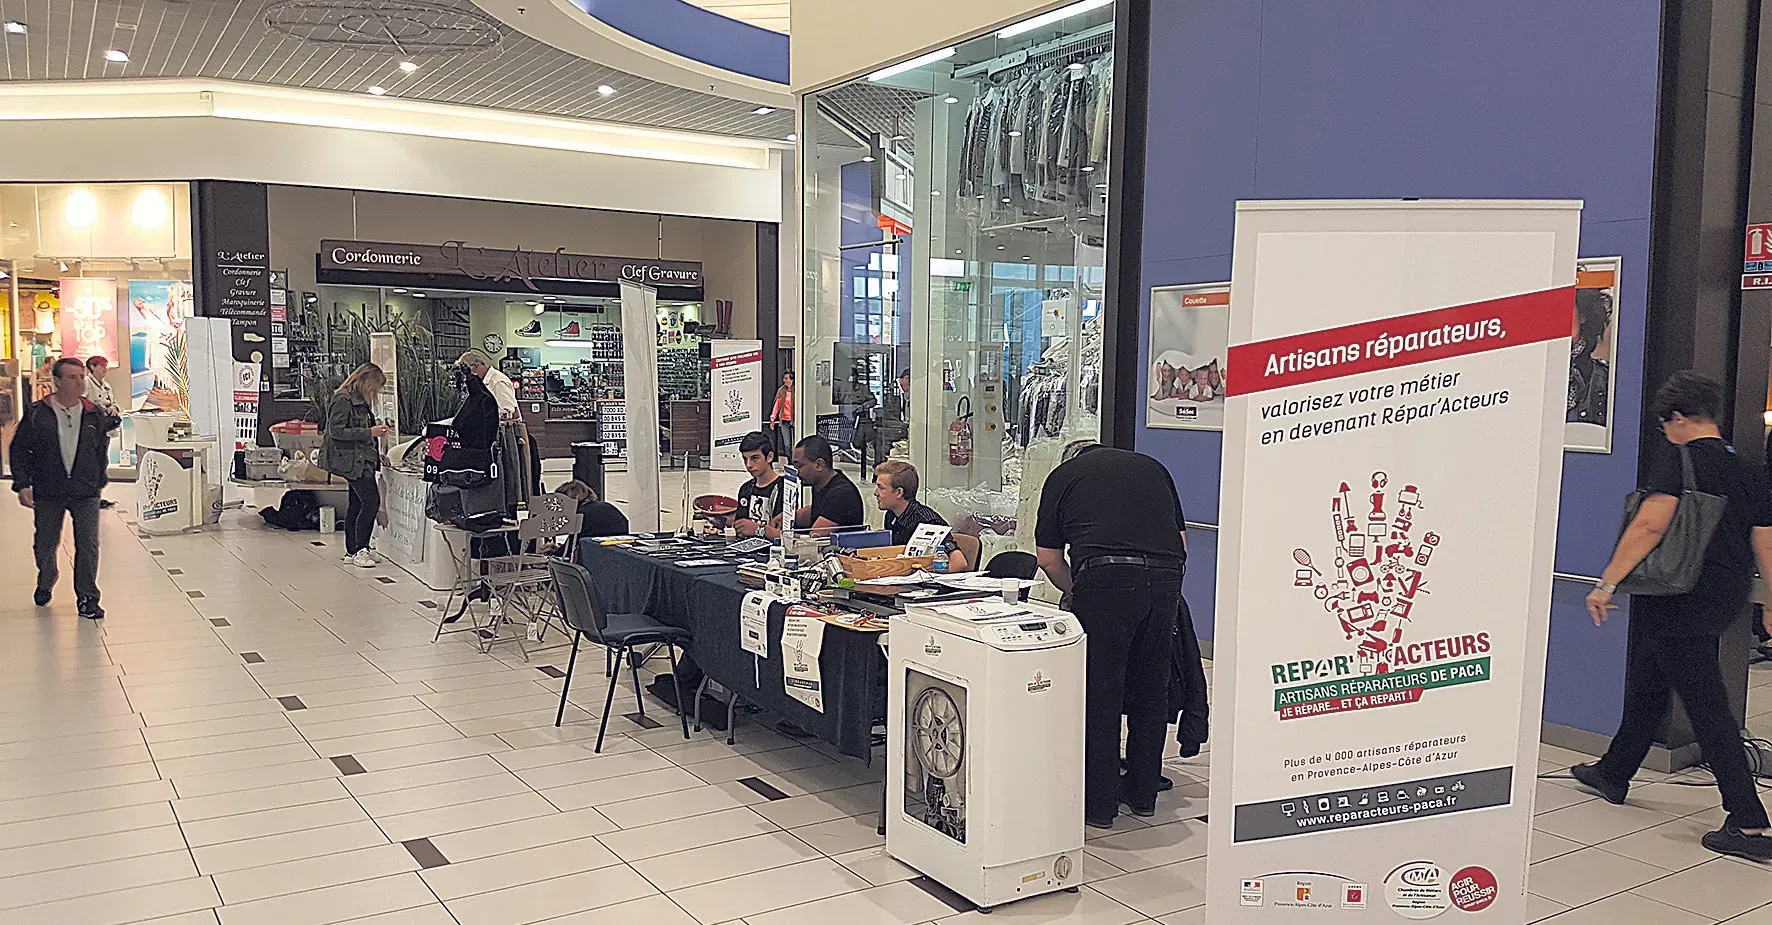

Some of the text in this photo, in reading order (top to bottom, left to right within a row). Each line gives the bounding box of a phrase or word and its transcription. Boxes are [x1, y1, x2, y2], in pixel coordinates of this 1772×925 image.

[217, 251, 265, 263] L'Atelier
[331, 247, 421, 265] Cordonnerie
[222, 267, 262, 276] Cordonnerie
[440, 240, 606, 292] L'Atelier
[621, 264, 698, 282] Clef Gravure
[235, 277, 252, 287] Clef
[229, 288, 257, 297] Gravure
[1184, 296, 1207, 305] Couette
[221, 298, 266, 307] Maroquinerie
[231, 318, 257, 328] Tampon
[75, 327, 107, 343] TOP
[1263, 317, 1508, 377] Artisans réparateurs,
[1260, 370, 1462, 420] valorisez votre métier
[1260, 388, 1510, 446] en devenant Répar'Acteurs
[1271, 632, 1492, 685] REPAR' ACTEURS
[1278, 663, 1484, 705] ARTISANS RÉPARATEURS DE PACA
[1281, 690, 1413, 718] JE RÉPARE... ET ÇA REPART !
[1283, 734, 1467, 769] Plus de 4 000 artisans réparateurs
[1291, 749, 1458, 783] en Provence-Alpes-Côte d'Azur
[1296, 794, 1457, 828] www.reparacteurs-paca.fr
[1451, 876, 1474, 891] AGIR
[1453, 883, 1480, 898] POUR
